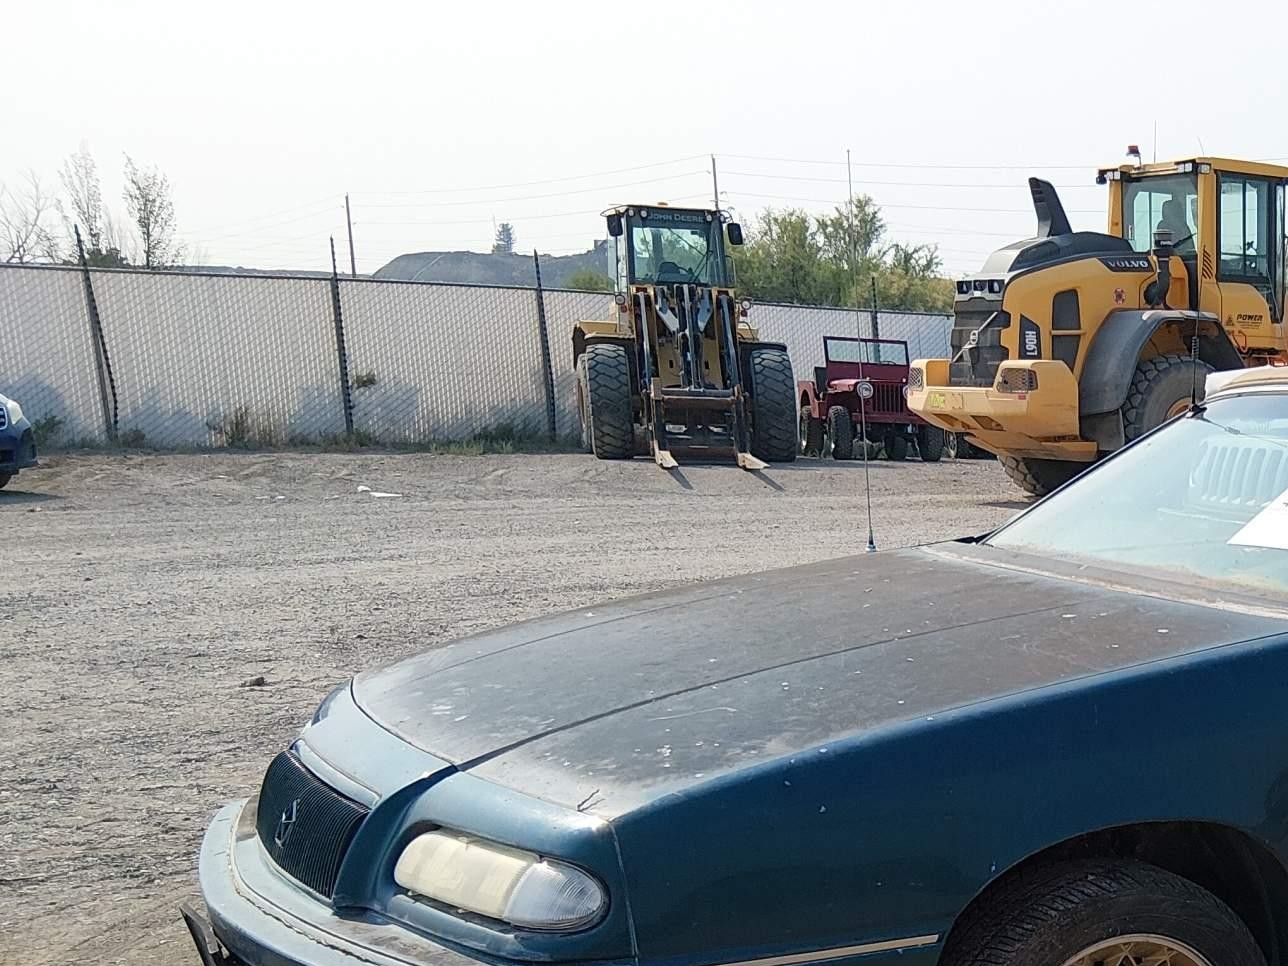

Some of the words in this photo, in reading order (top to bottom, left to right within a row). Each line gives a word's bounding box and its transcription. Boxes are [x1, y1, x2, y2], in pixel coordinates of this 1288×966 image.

[674, 214, 704, 222] DEERE
[1236, 313, 1263, 321] POWER
[1025, 330, 1037, 356] L90H
